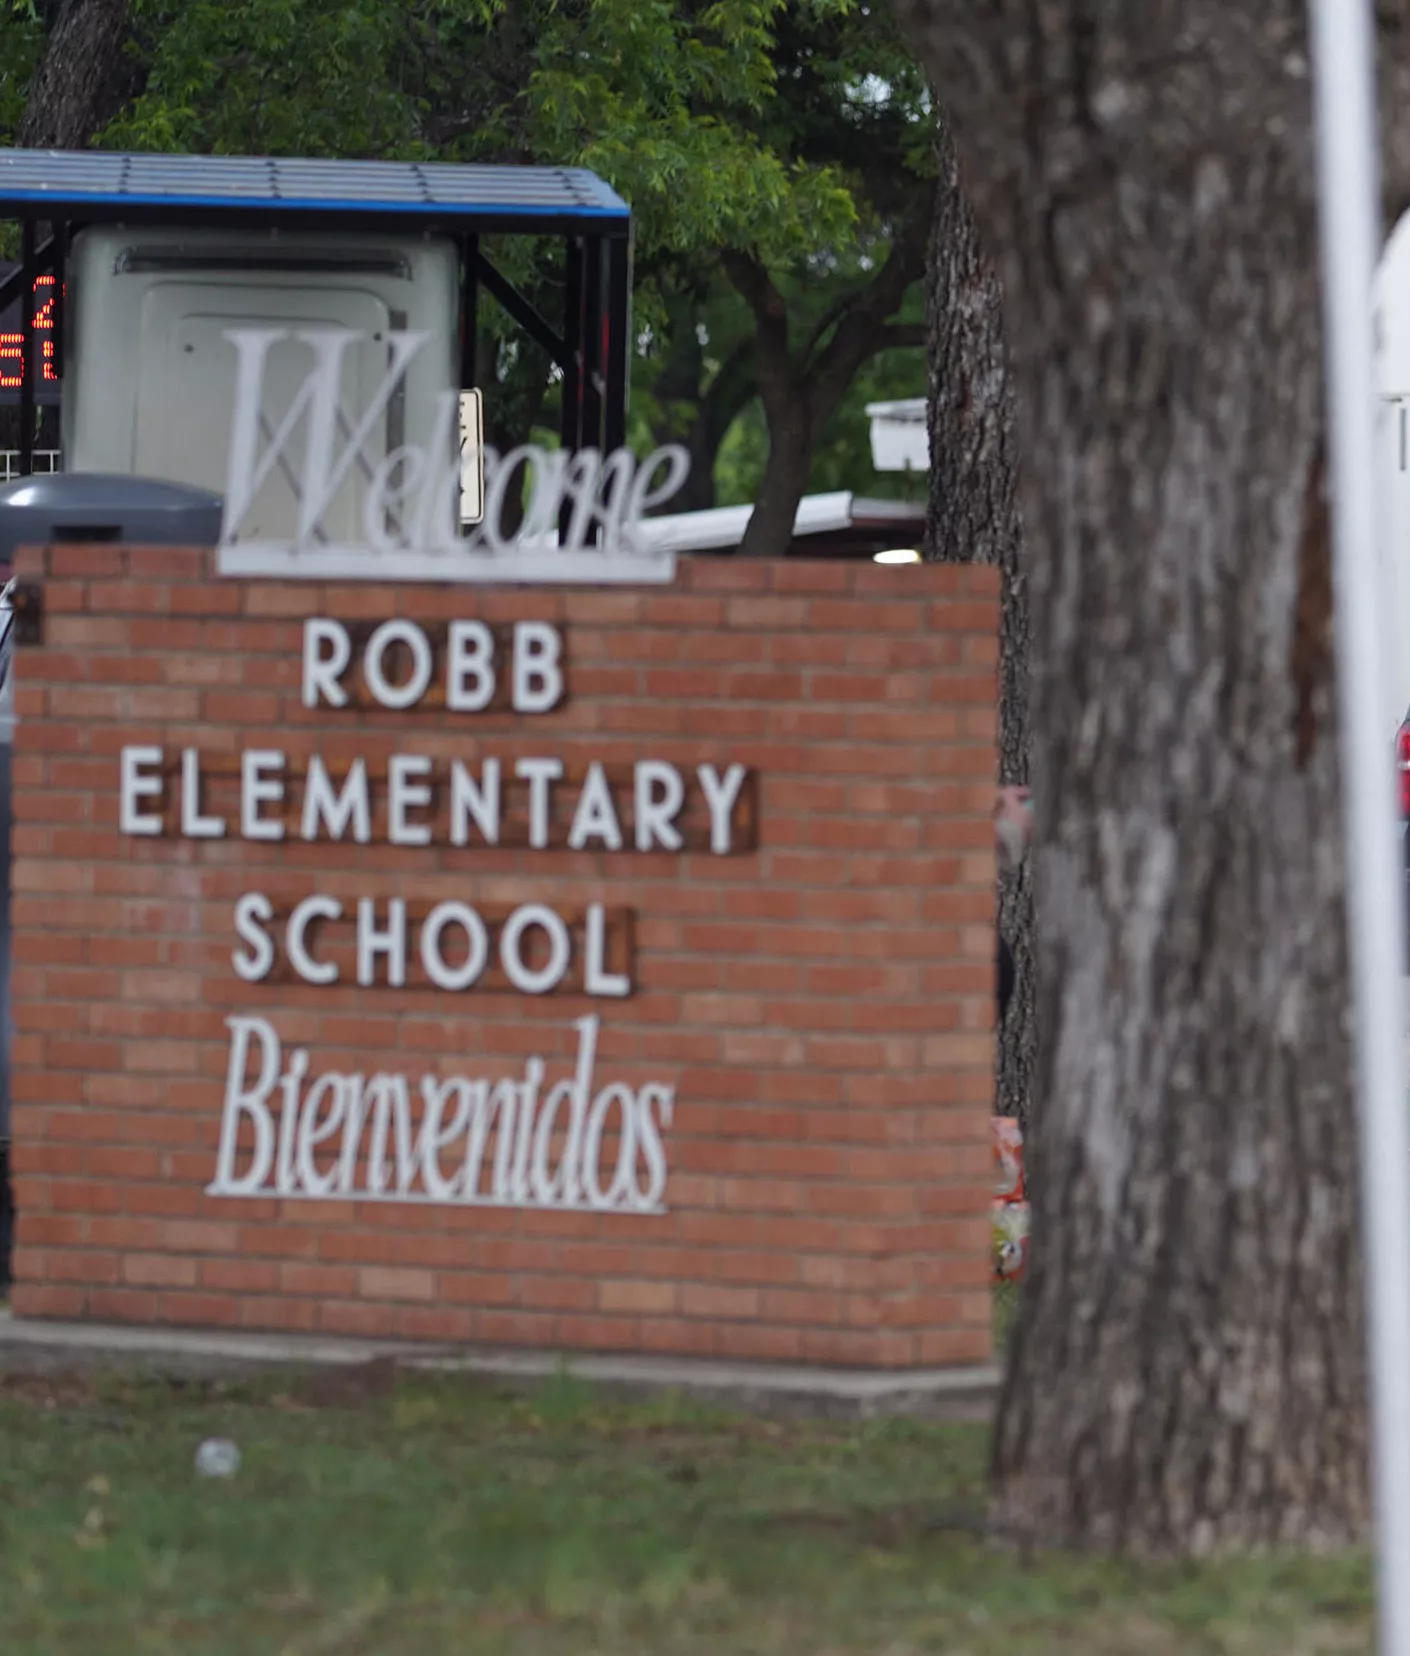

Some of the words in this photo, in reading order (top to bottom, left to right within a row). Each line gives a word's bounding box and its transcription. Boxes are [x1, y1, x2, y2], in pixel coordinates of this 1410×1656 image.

[222, 329, 691, 556] Welcome
[301, 618, 566, 713] ROBB
[119, 745, 746, 853] ELEMENTARY
[231, 892, 631, 996] SCHOOL
[208, 1014, 675, 1212] Bienvenidos
